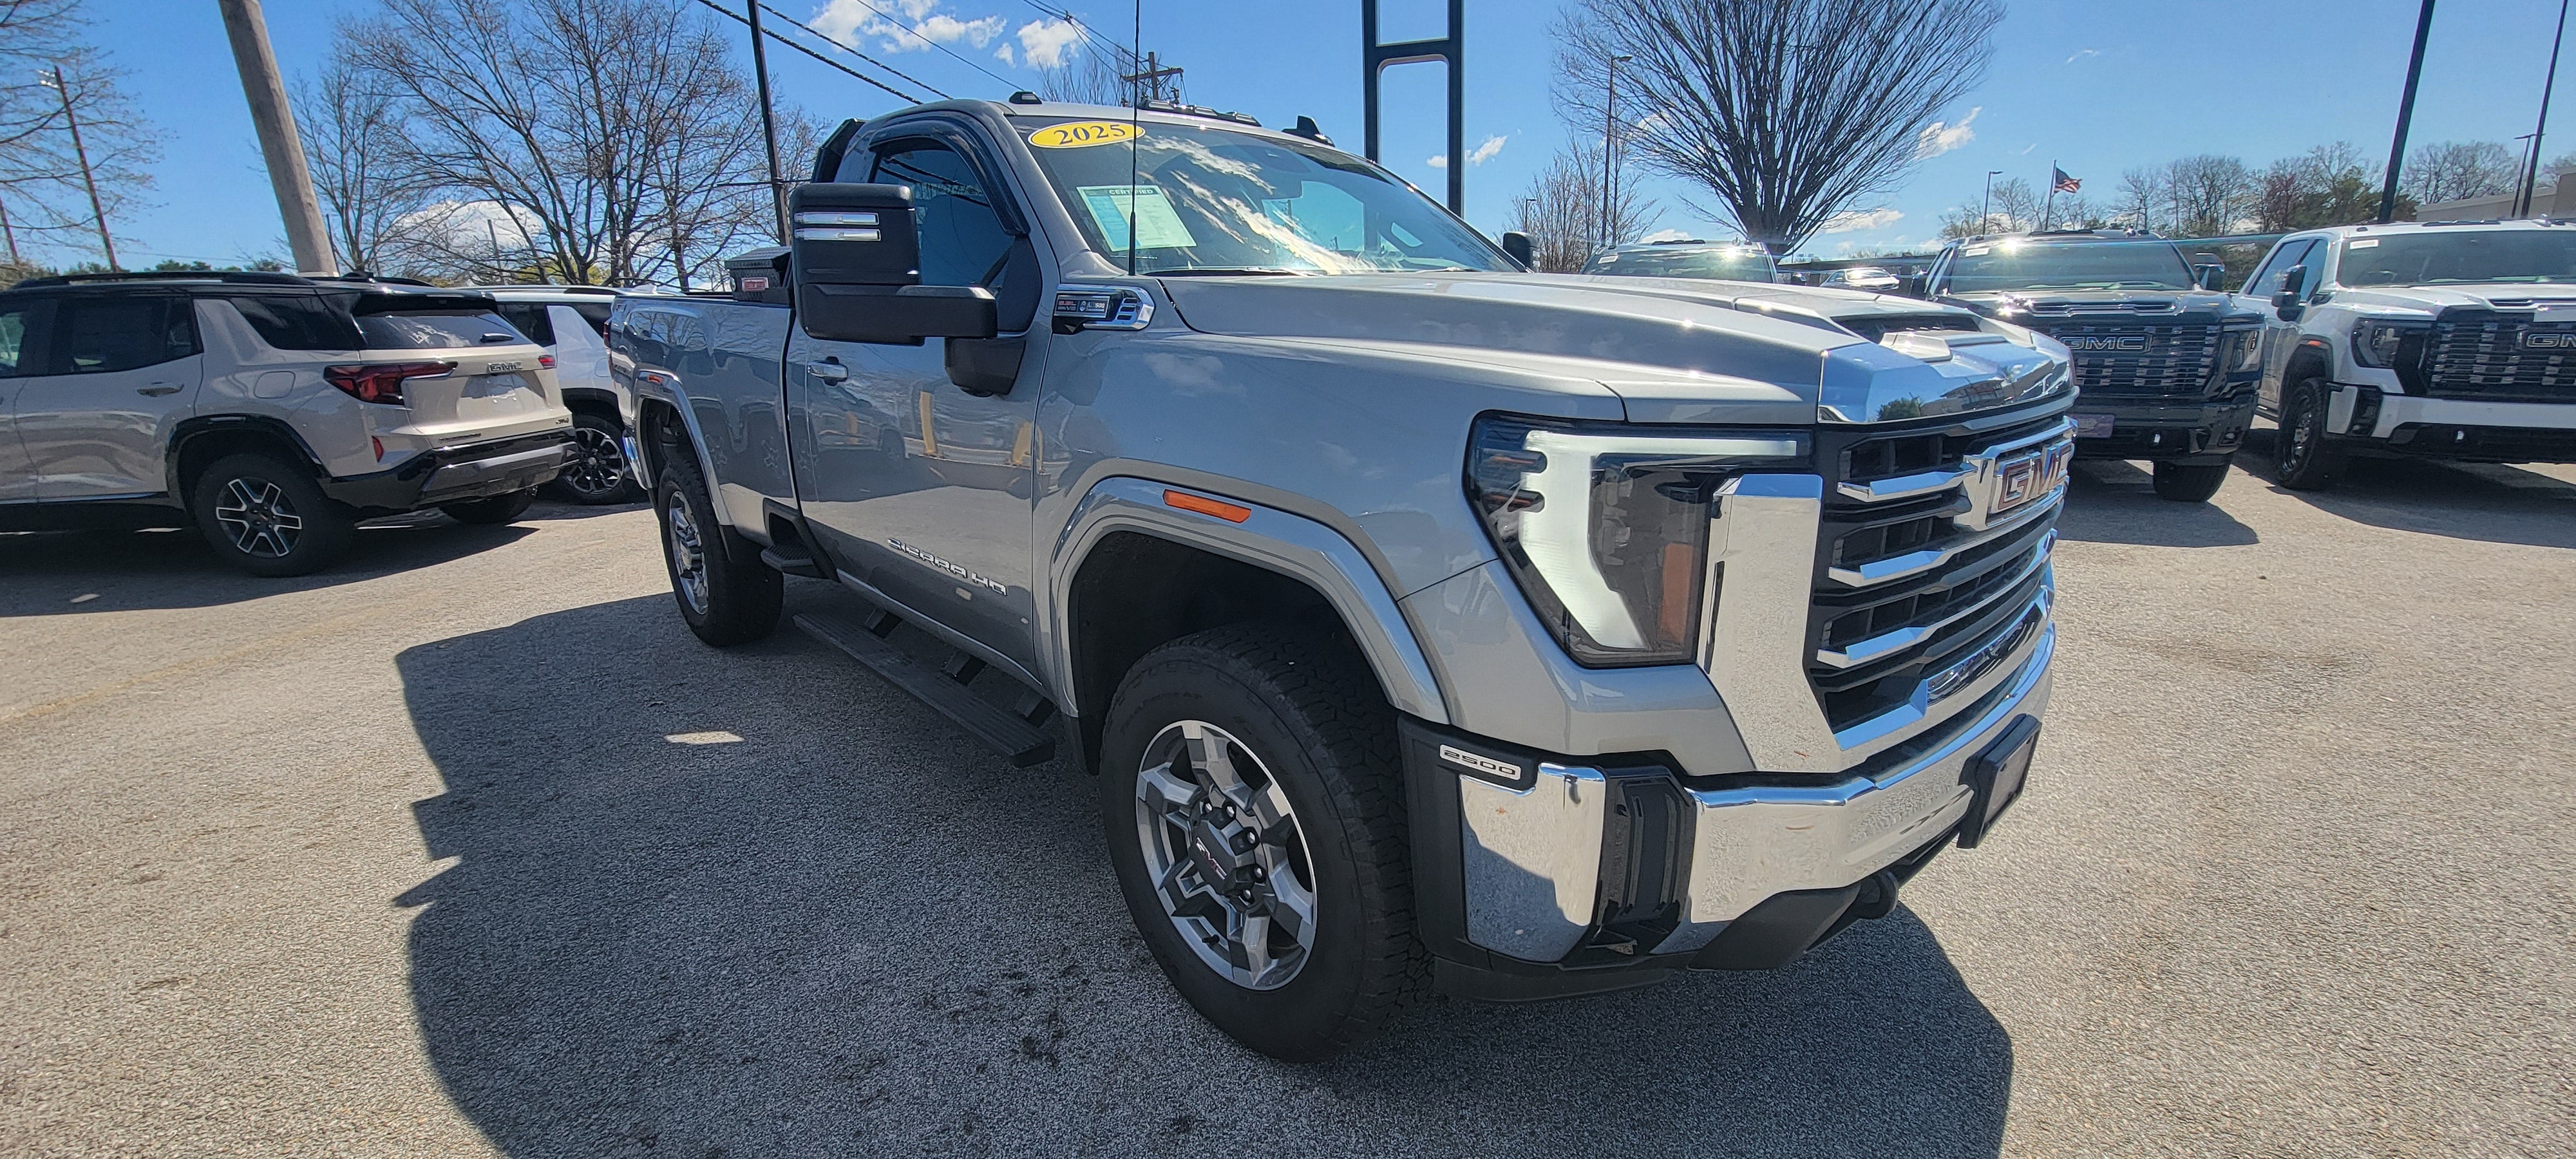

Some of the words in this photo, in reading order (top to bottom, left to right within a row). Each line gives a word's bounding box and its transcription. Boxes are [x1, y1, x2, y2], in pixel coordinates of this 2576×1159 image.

[1054, 124, 1126, 146] 2025
[2061, 336, 2145, 350] GMC
[488, 362, 523, 373] GMC
[1991, 439, 2074, 514] GMC
[887, 537, 968, 578] SIERRA
[971, 572, 1007, 596] HD
[1444, 749, 1515, 775] 2500
[1195, 836, 1227, 880] GMC
